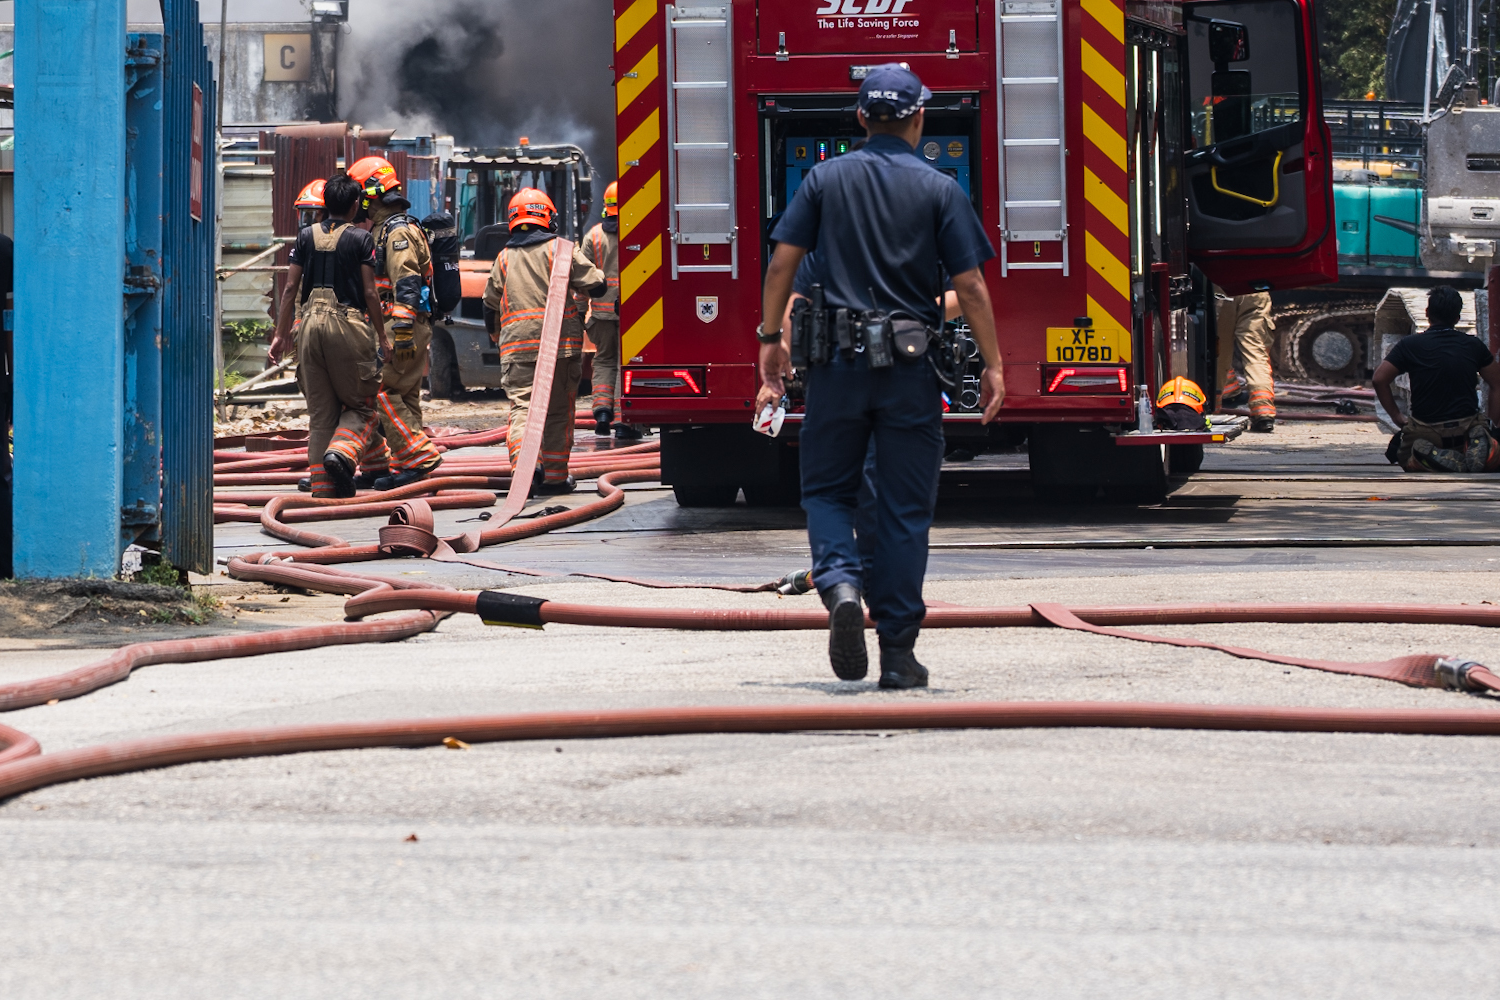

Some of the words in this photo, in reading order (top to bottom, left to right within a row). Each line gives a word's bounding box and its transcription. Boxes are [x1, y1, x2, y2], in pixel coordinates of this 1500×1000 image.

[817, 19, 835, 29] The
[838, 18, 854, 28] Life
[857, 18, 889, 30] Saving
[893, 18, 919, 28] Force
[280, 45, 296, 70] C
[867, 90, 899, 101] POLICE
[1071, 329, 1095, 345] XF
[1056, 346, 1112, 362] 1078D
